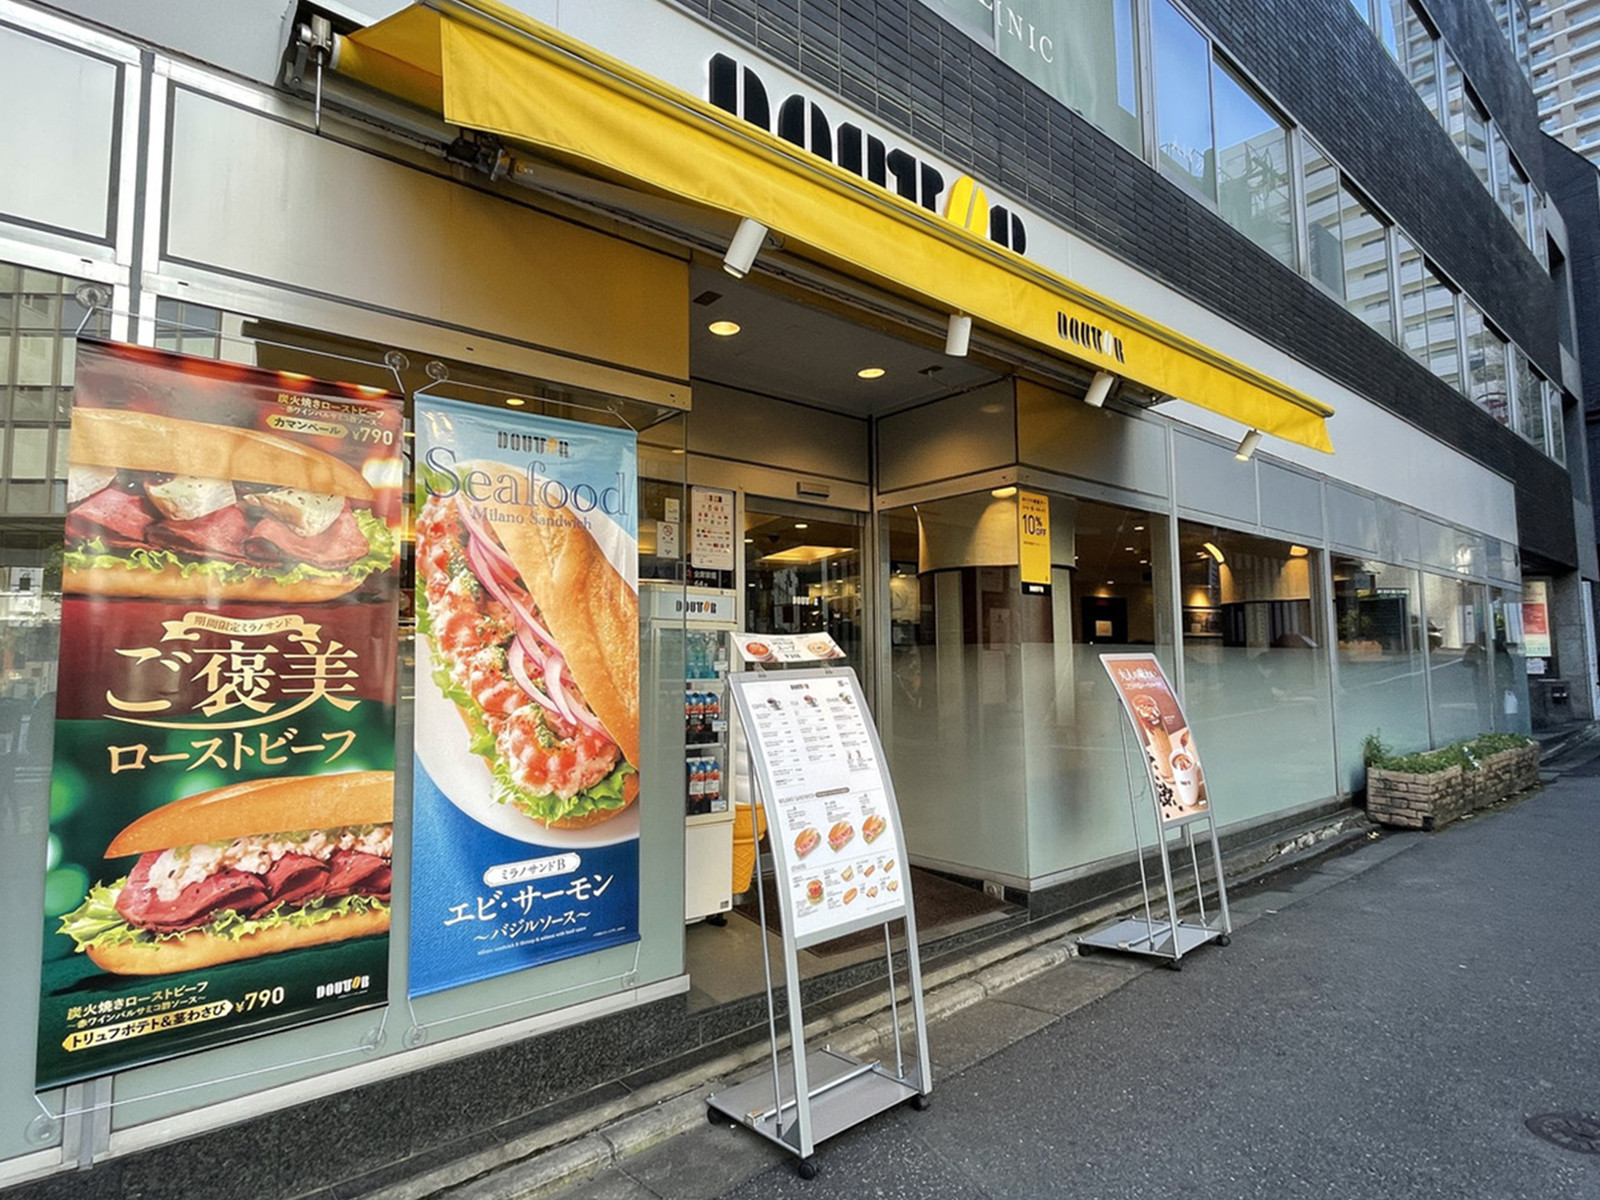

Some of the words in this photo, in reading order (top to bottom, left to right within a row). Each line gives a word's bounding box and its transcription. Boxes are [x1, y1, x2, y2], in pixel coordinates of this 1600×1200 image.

[978, 0, 1054, 64] INIC
[1057, 310, 1125, 364] DOUTOR
[274, 417, 341, 435] カマンベール
[352, 426, 393, 446] ¥790
[497, 430, 570, 458] DOUTOR
[424, 446, 629, 516] Seafood
[471, 506, 525, 525] Milano
[530, 510, 593, 530] Sandwich
[194, 614, 293, 634] 期間限定ミラノサンド
[105, 639, 362, 718] ご褒美
[107, 727, 357, 775] ローストビーフ
[500, 858, 567, 881] ミラノサンドB
[443, 874, 615, 927] エビ・サーモン
[66, 981, 210, 1021] 炭火焼きローストビーフ
[235, 986, 285, 1014] ¥790
[316, 975, 370, 1000] DOUTOR
